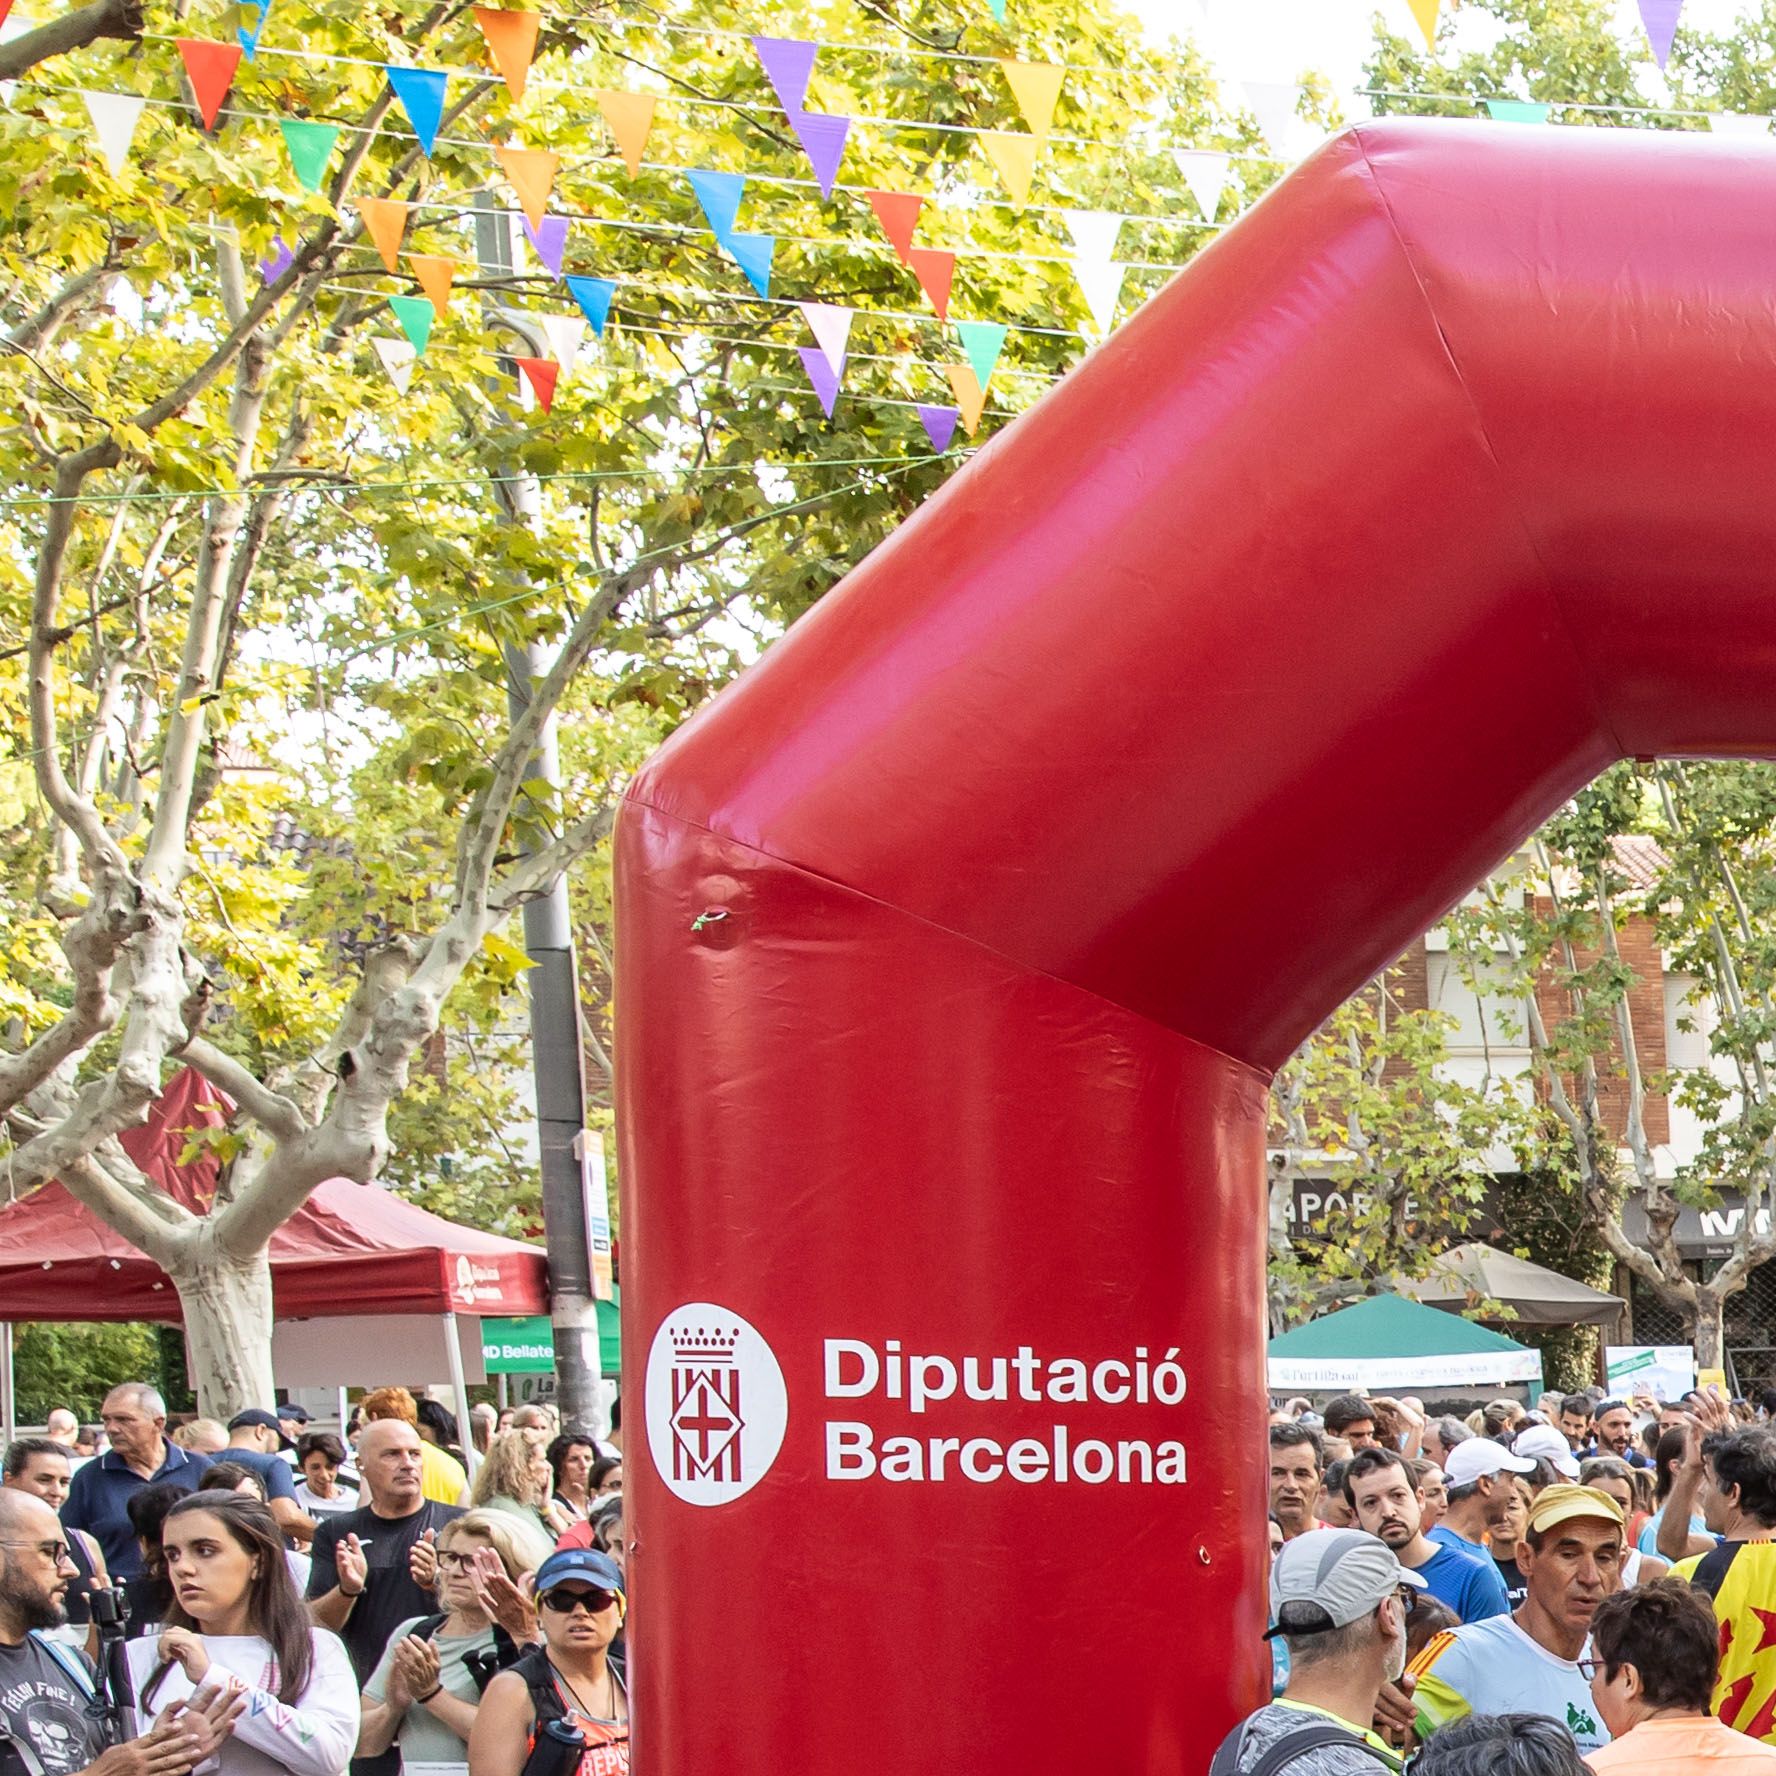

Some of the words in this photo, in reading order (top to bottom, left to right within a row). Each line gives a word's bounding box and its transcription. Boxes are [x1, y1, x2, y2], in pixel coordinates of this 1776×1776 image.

[502, 1344, 554, 1360] Bellate
[823, 1338, 1188, 1413] Diputació
[824, 1420, 1188, 1485] Barcelona
